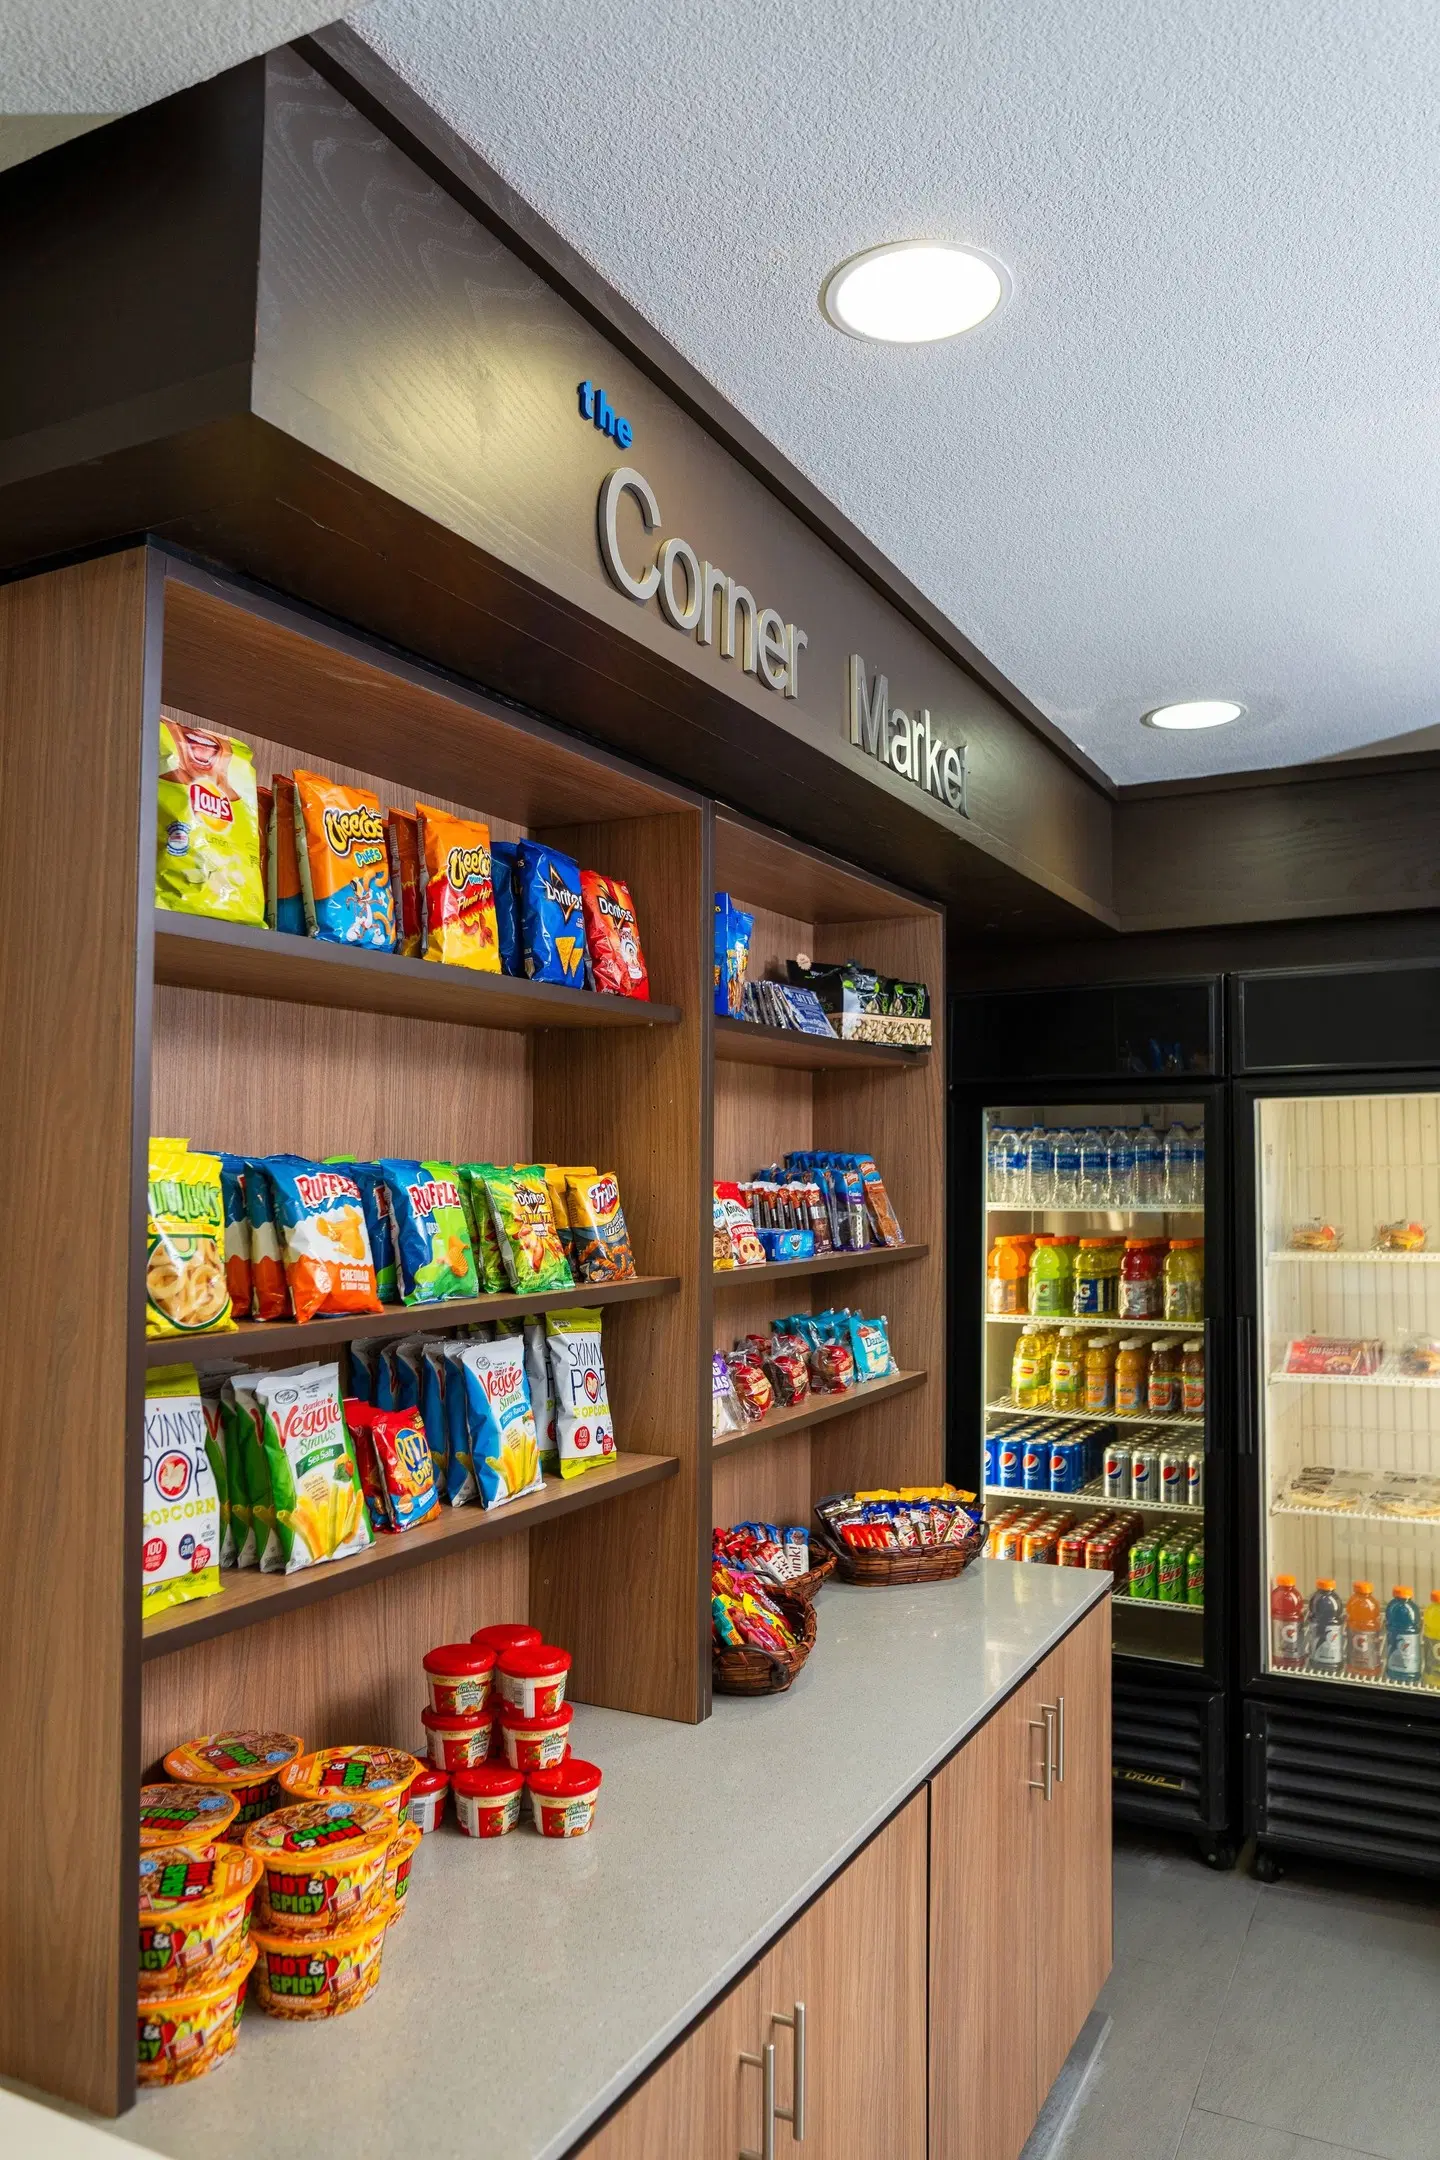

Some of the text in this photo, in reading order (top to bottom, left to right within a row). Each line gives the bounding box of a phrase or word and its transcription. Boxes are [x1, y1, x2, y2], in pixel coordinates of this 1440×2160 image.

[578, 380, 633, 450] the
[599, 466, 808, 699] Corner
[193, 785, 230, 819] Lay's
[356, 849, 382, 867] Puffs
[599, 897, 634, 922] Doritos
[517, 1192, 546, 1206] Doritos
[568, 1339, 602, 1367] SKINN
[479, 1369, 522, 1404] Veggie
[145, 1408, 203, 1449] KINNY
[272, 1403, 341, 1448] Veggie
[307, 1448, 335, 1467] Sea Salt
[395, 1433, 429, 1468] RITZ
[147, 1542, 162, 1555] 100
[267, 1870, 324, 1896] HOT &
[270, 1894, 325, 1914] SPICY
[152, 1932, 170, 1949] &
[267, 1952, 325, 1977] HOT &
[270, 1975, 325, 1996] SPICY
